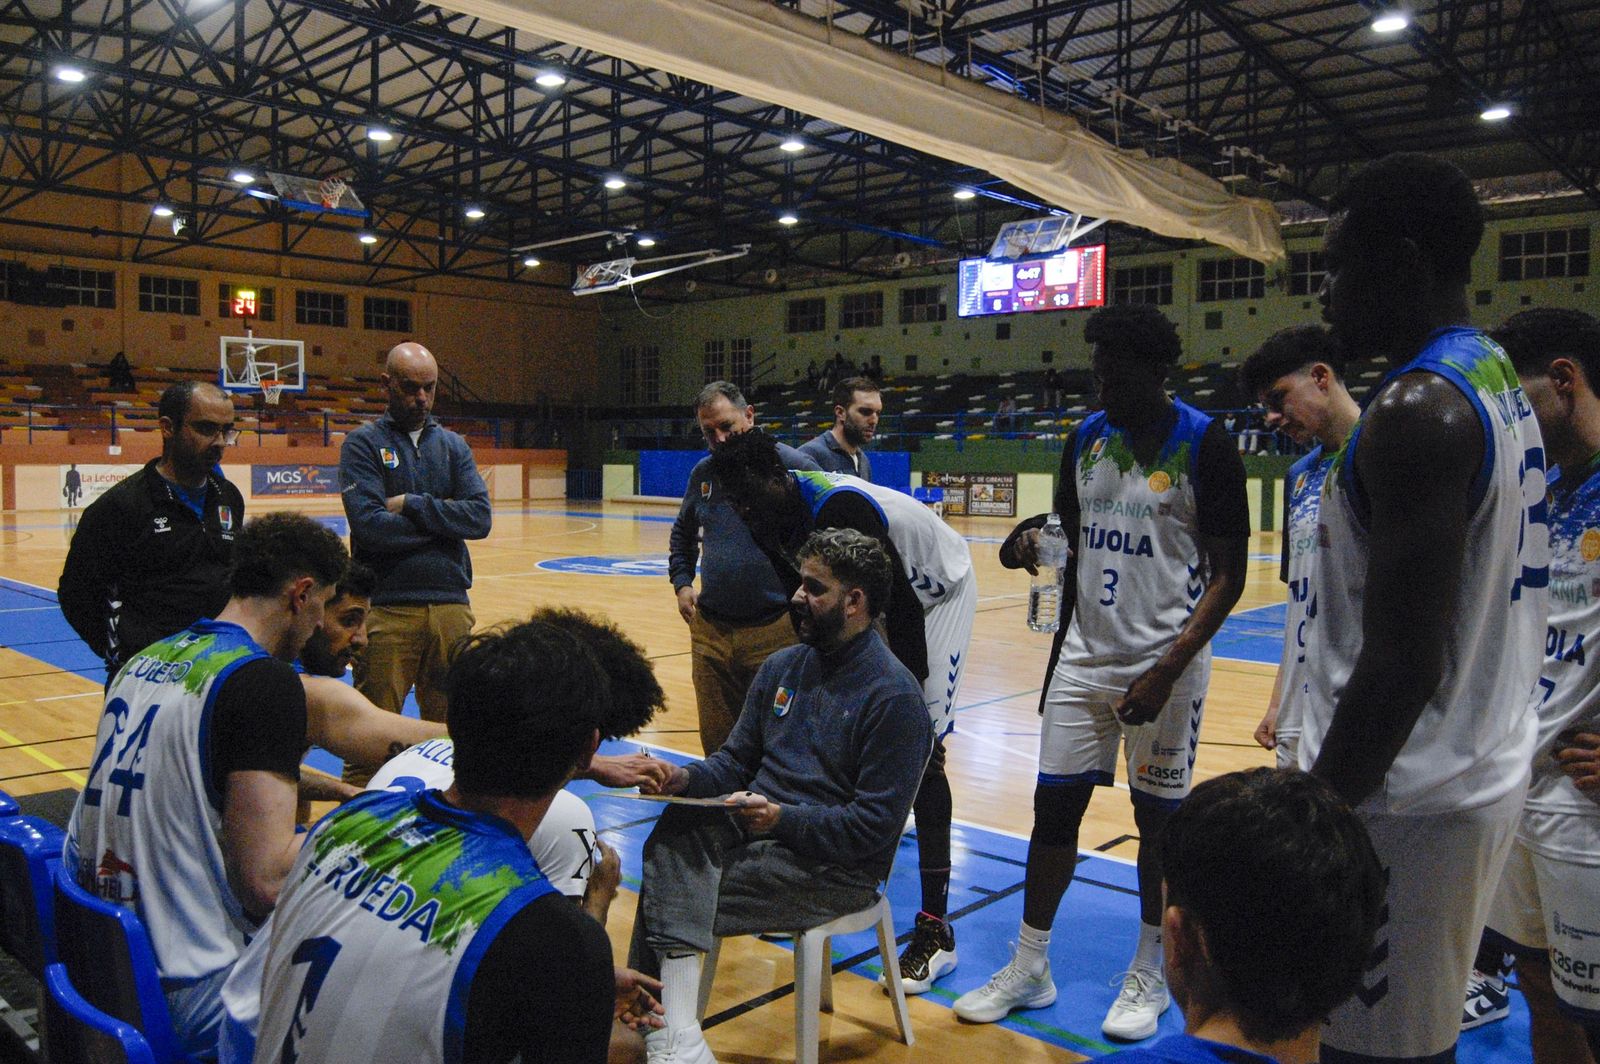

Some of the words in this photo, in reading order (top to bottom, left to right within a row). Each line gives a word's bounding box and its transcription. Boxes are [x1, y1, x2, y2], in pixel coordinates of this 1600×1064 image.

[235, 299, 255, 315] 24
[1053, 294, 1069, 306] 13
[81, 474, 92, 483] La
[266, 471, 302, 484] MGS
[1082, 522, 1154, 558] TÍJOLA
[1099, 568, 1119, 606] 3
[84, 696, 161, 818] 24
[324, 855, 441, 943] RUEDA
